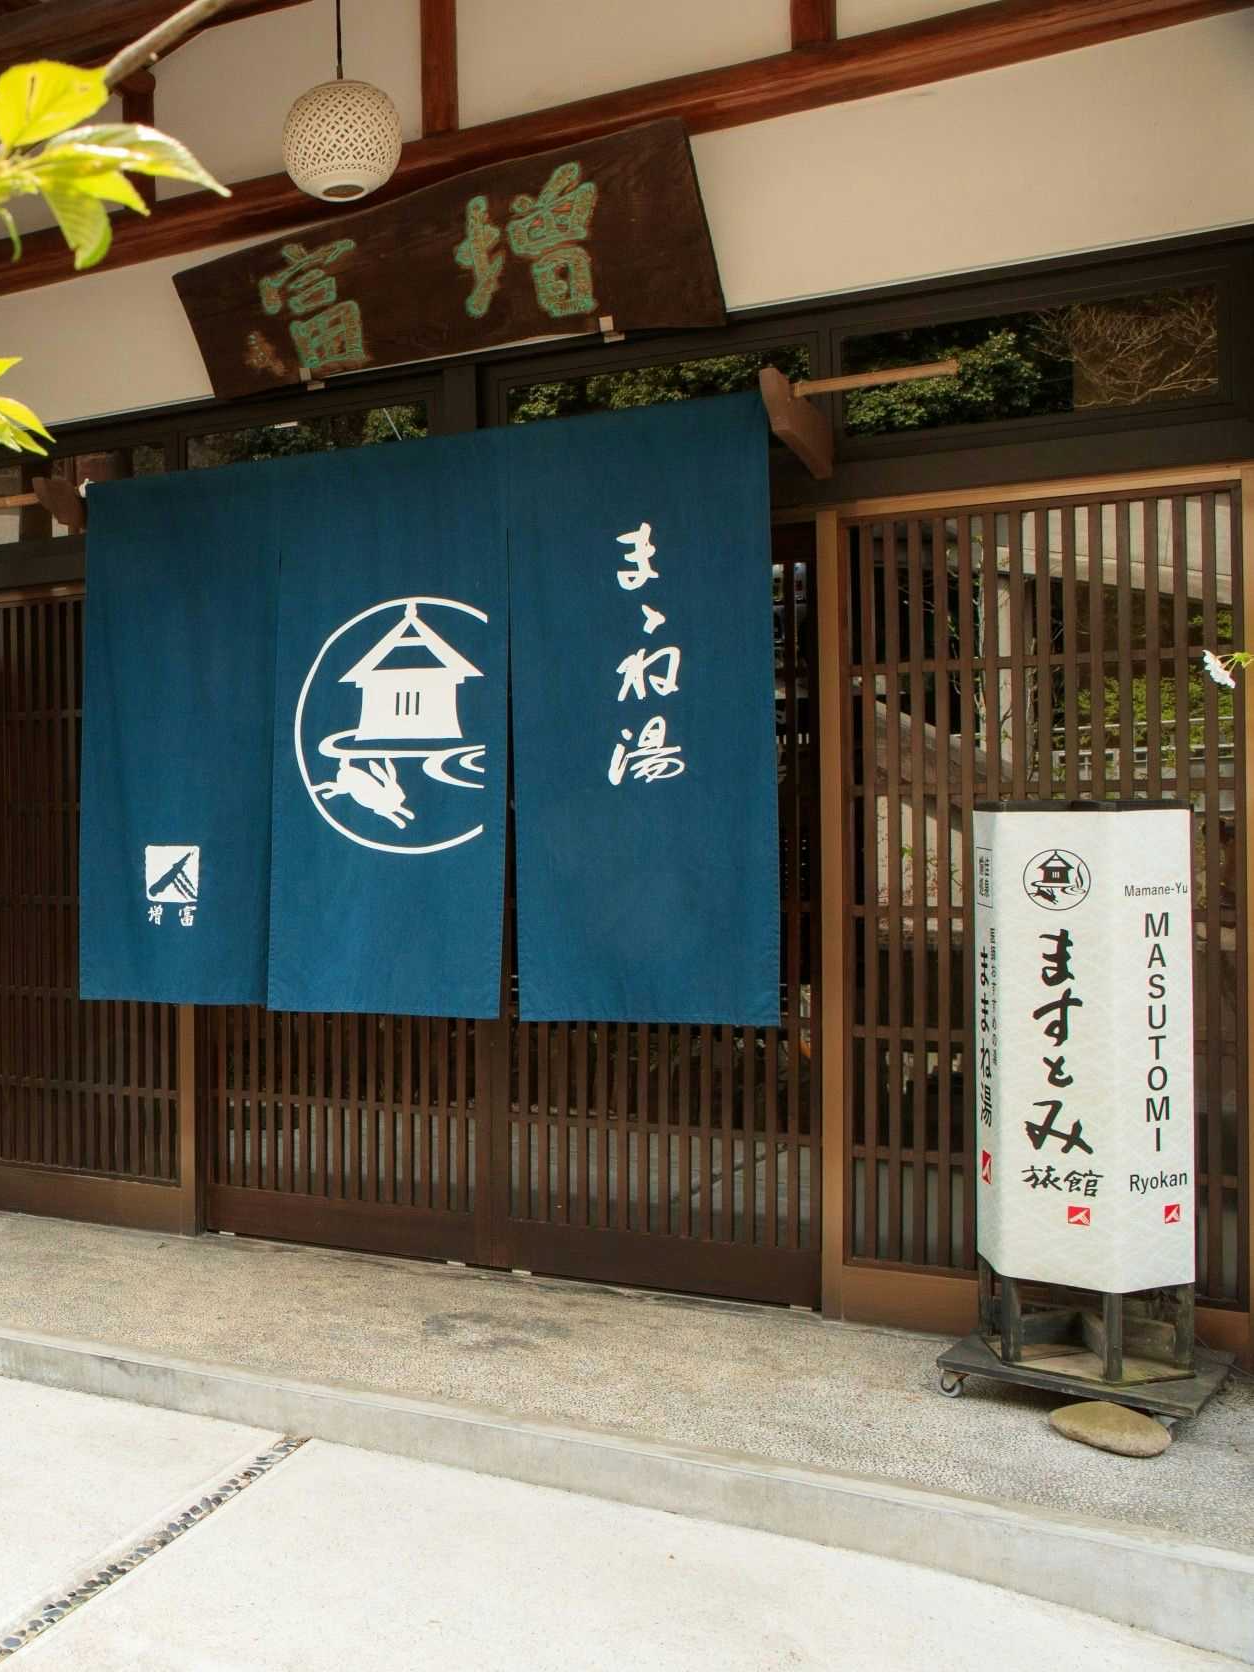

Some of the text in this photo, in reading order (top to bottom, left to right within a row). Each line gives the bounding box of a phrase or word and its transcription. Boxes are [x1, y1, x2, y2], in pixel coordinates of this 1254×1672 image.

[1124, 883, 1189, 897] Mamane-Yu
[980, 945, 994, 1129] ままね湯
[1024, 928, 1094, 1155] ますとみ
[1145, 911, 1170, 1152] MASUTOMI
[1021, 1165, 1105, 1198] 旅館
[1129, 1170, 1188, 1195] Ryokan
